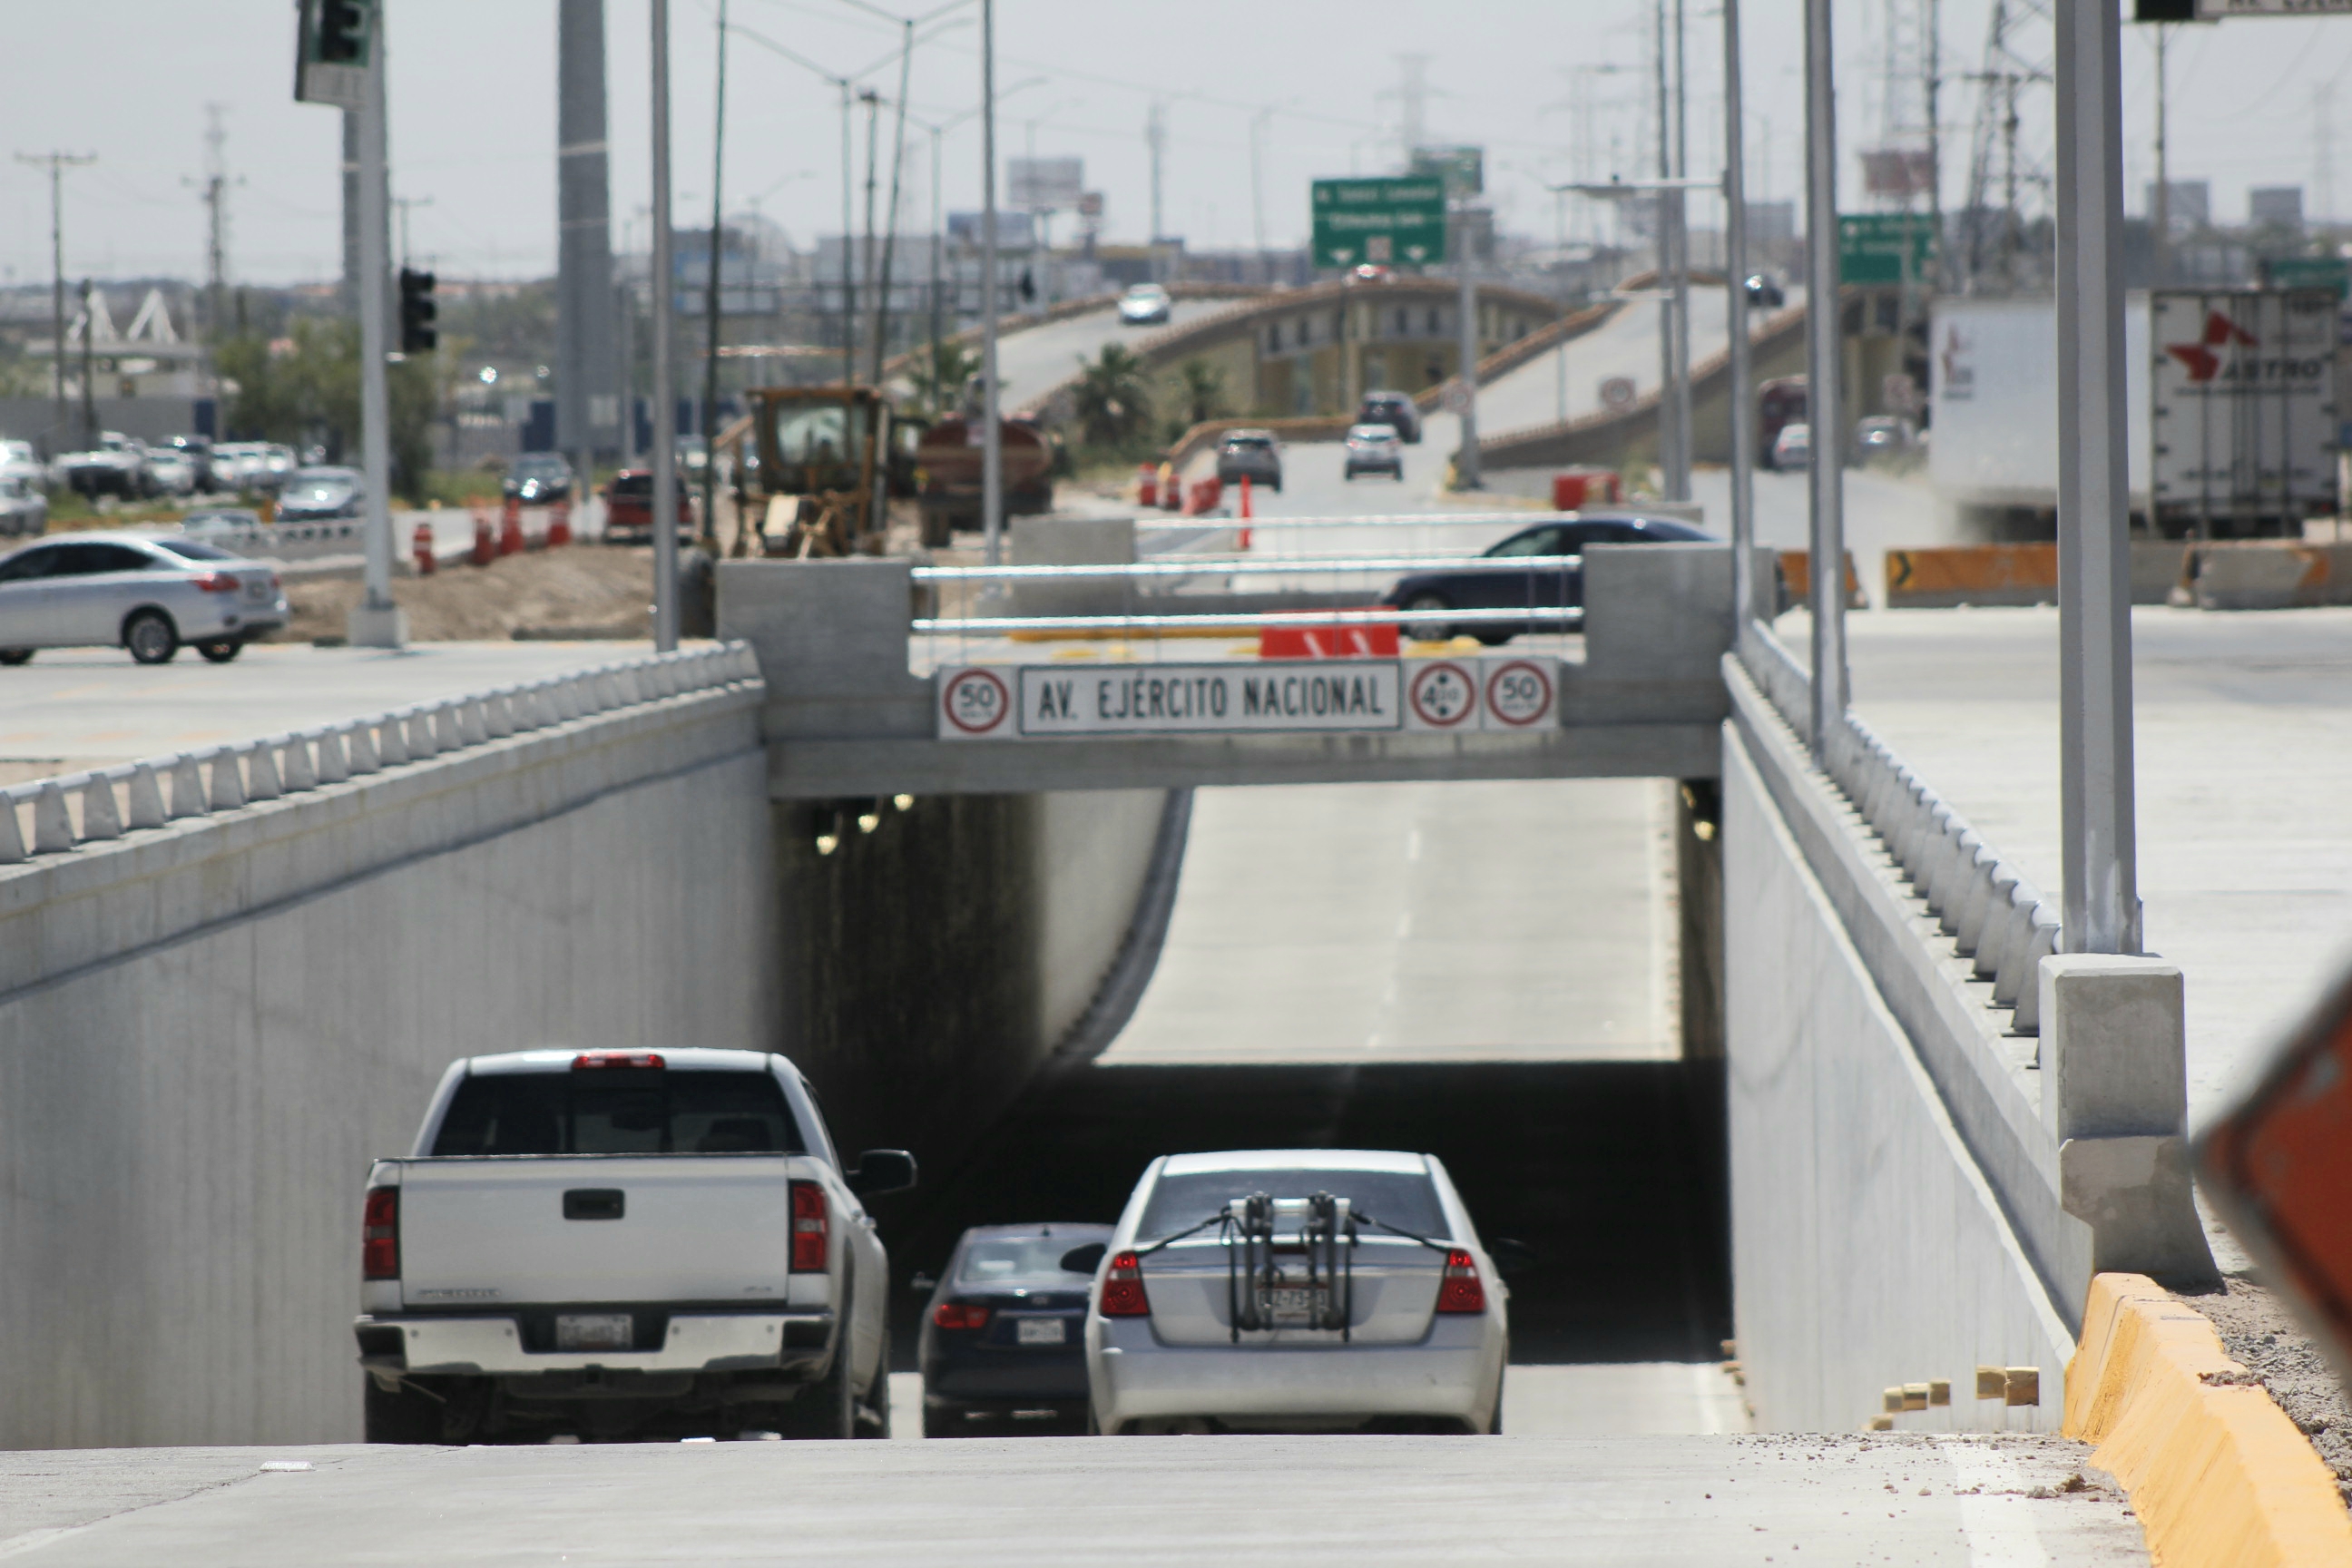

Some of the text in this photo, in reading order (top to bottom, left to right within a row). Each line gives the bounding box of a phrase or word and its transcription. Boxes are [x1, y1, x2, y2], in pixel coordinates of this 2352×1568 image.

[959, 683, 995, 708] 50
[1038, 670, 1386, 720] AV. EJÉRCITO NACIONAL
[1503, 676, 1538, 701] 50
